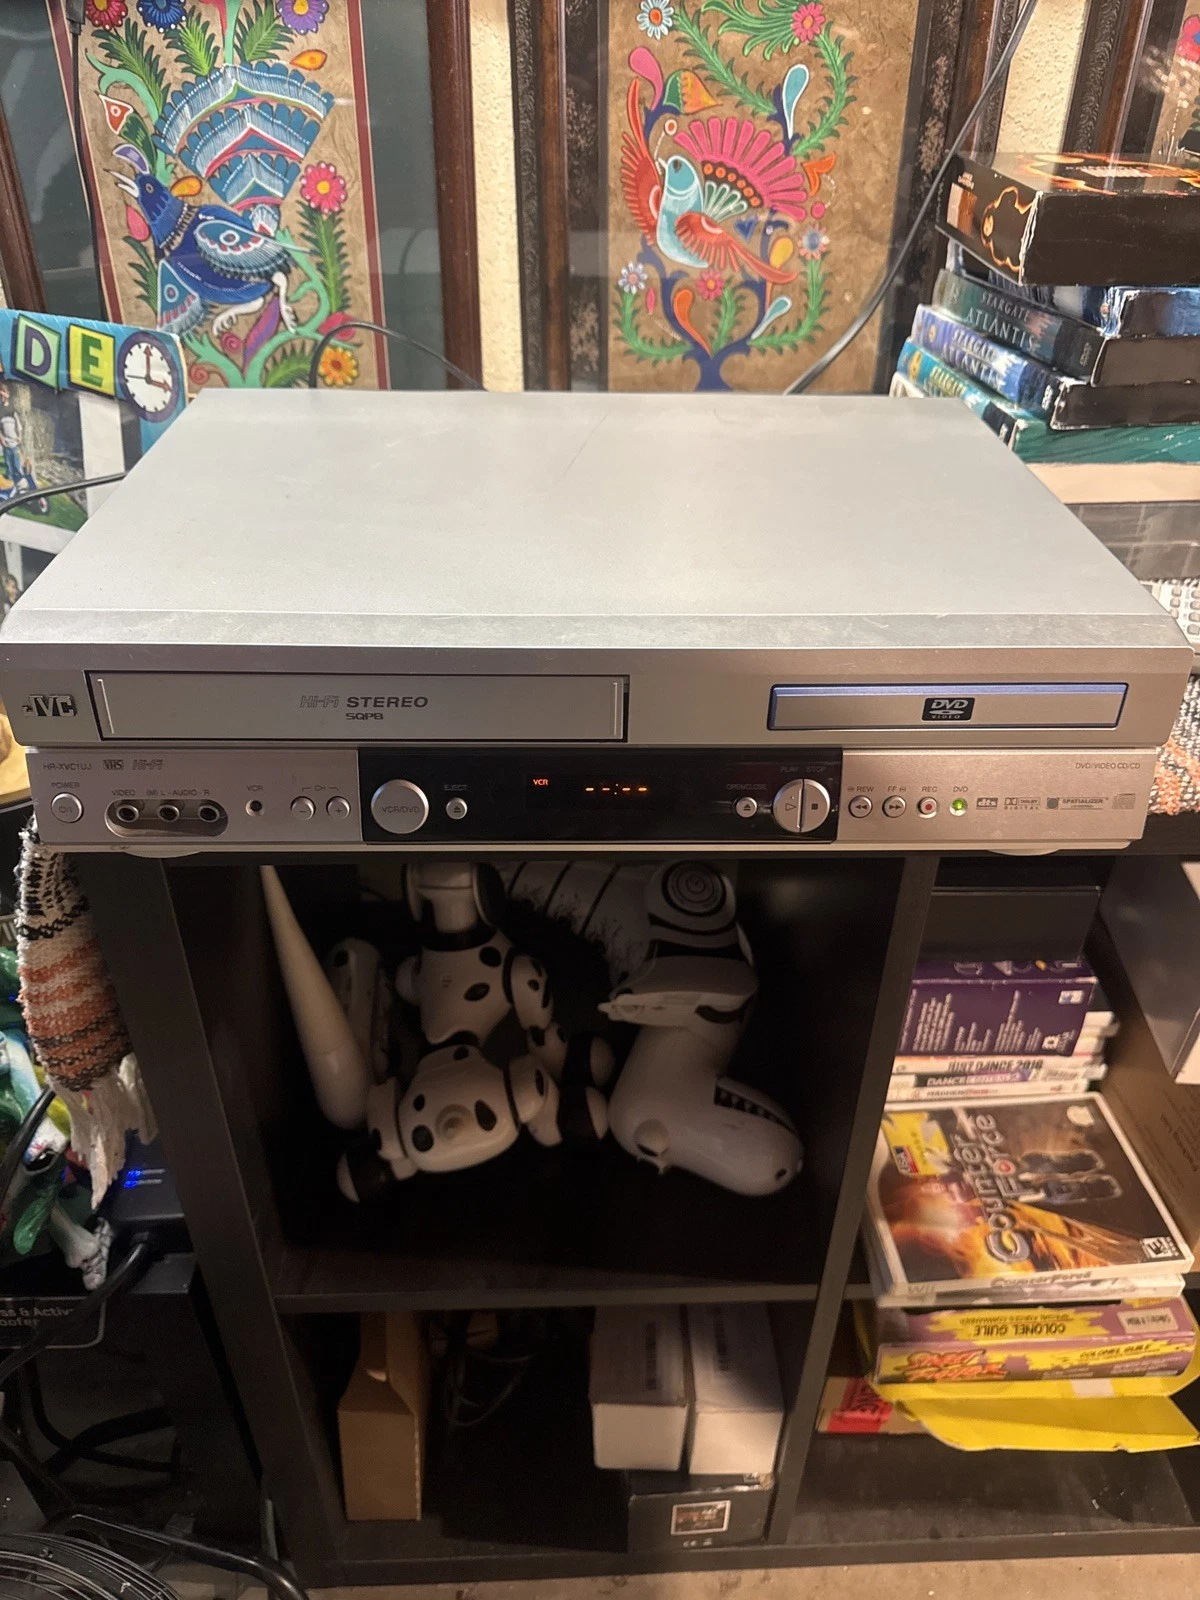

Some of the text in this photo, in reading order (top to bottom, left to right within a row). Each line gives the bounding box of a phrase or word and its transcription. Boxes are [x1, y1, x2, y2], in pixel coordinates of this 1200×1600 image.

[981, 292, 1030, 321] STARGATE
[966, 307, 1035, 351] ATLANTIS
[22, 693, 77, 717] JVC
[346, 696, 429, 708] STEREO
[931, 699, 969, 710] DVD
[345, 712, 384, 721] SQPB
[103, 759, 125, 771] VHS
[246, 784, 264, 792] VCR
[532, 778, 549, 786] VCR
[972, 1323, 1066, 1337] COLONEL GUILE
